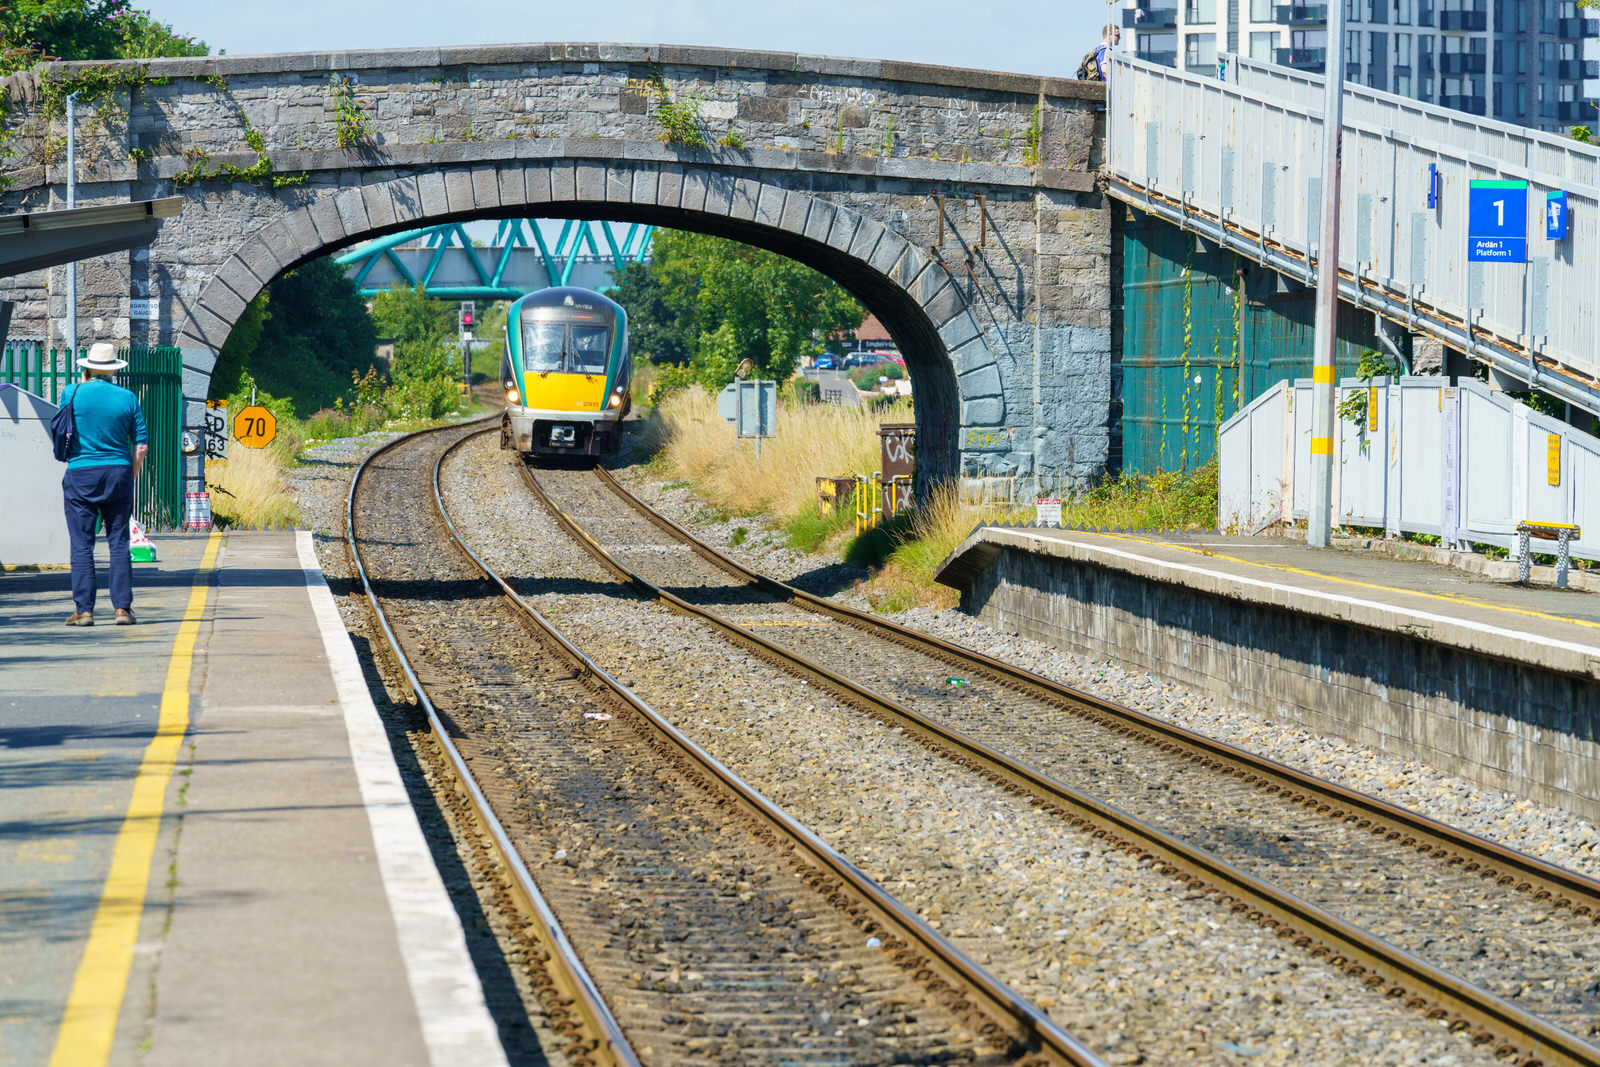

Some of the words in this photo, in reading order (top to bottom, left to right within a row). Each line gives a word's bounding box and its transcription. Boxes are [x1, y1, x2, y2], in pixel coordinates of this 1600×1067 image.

[1493, 200, 1504, 226] 1
[1476, 249, 1506, 257] Platform
[245, 418, 265, 437] 70
